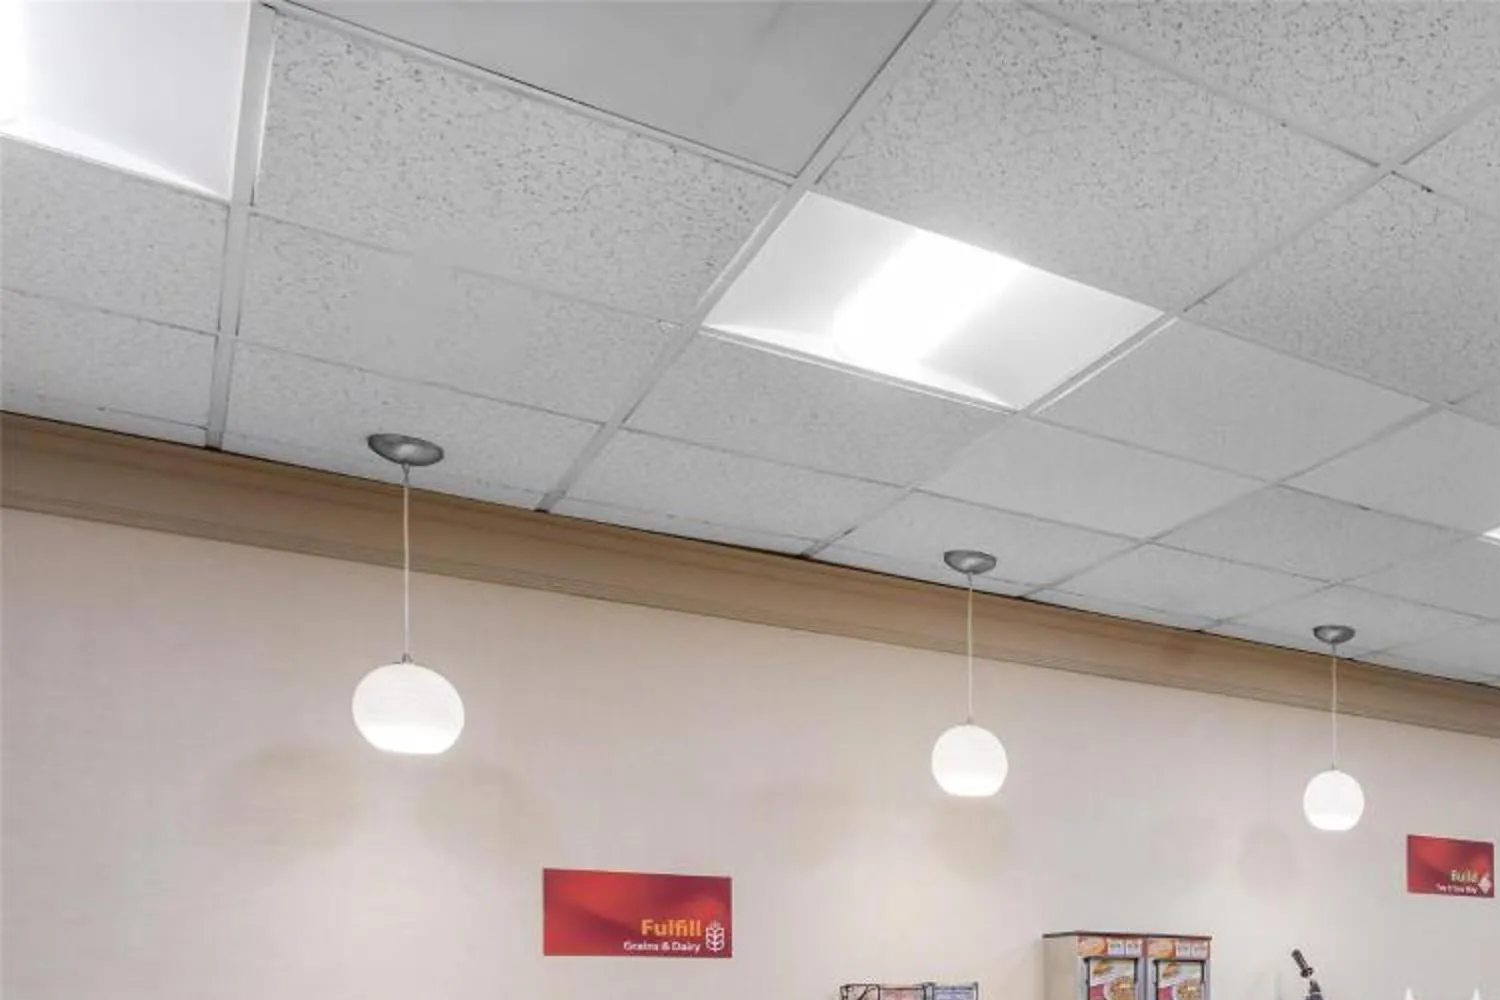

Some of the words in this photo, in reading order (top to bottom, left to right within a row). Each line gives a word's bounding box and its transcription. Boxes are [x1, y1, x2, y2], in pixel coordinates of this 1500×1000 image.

[641, 919, 702, 937] Fulfill
[623, 941, 659, 951] Grains
[661, 941, 670, 951] &
[672, 941, 702, 953] Dairy
